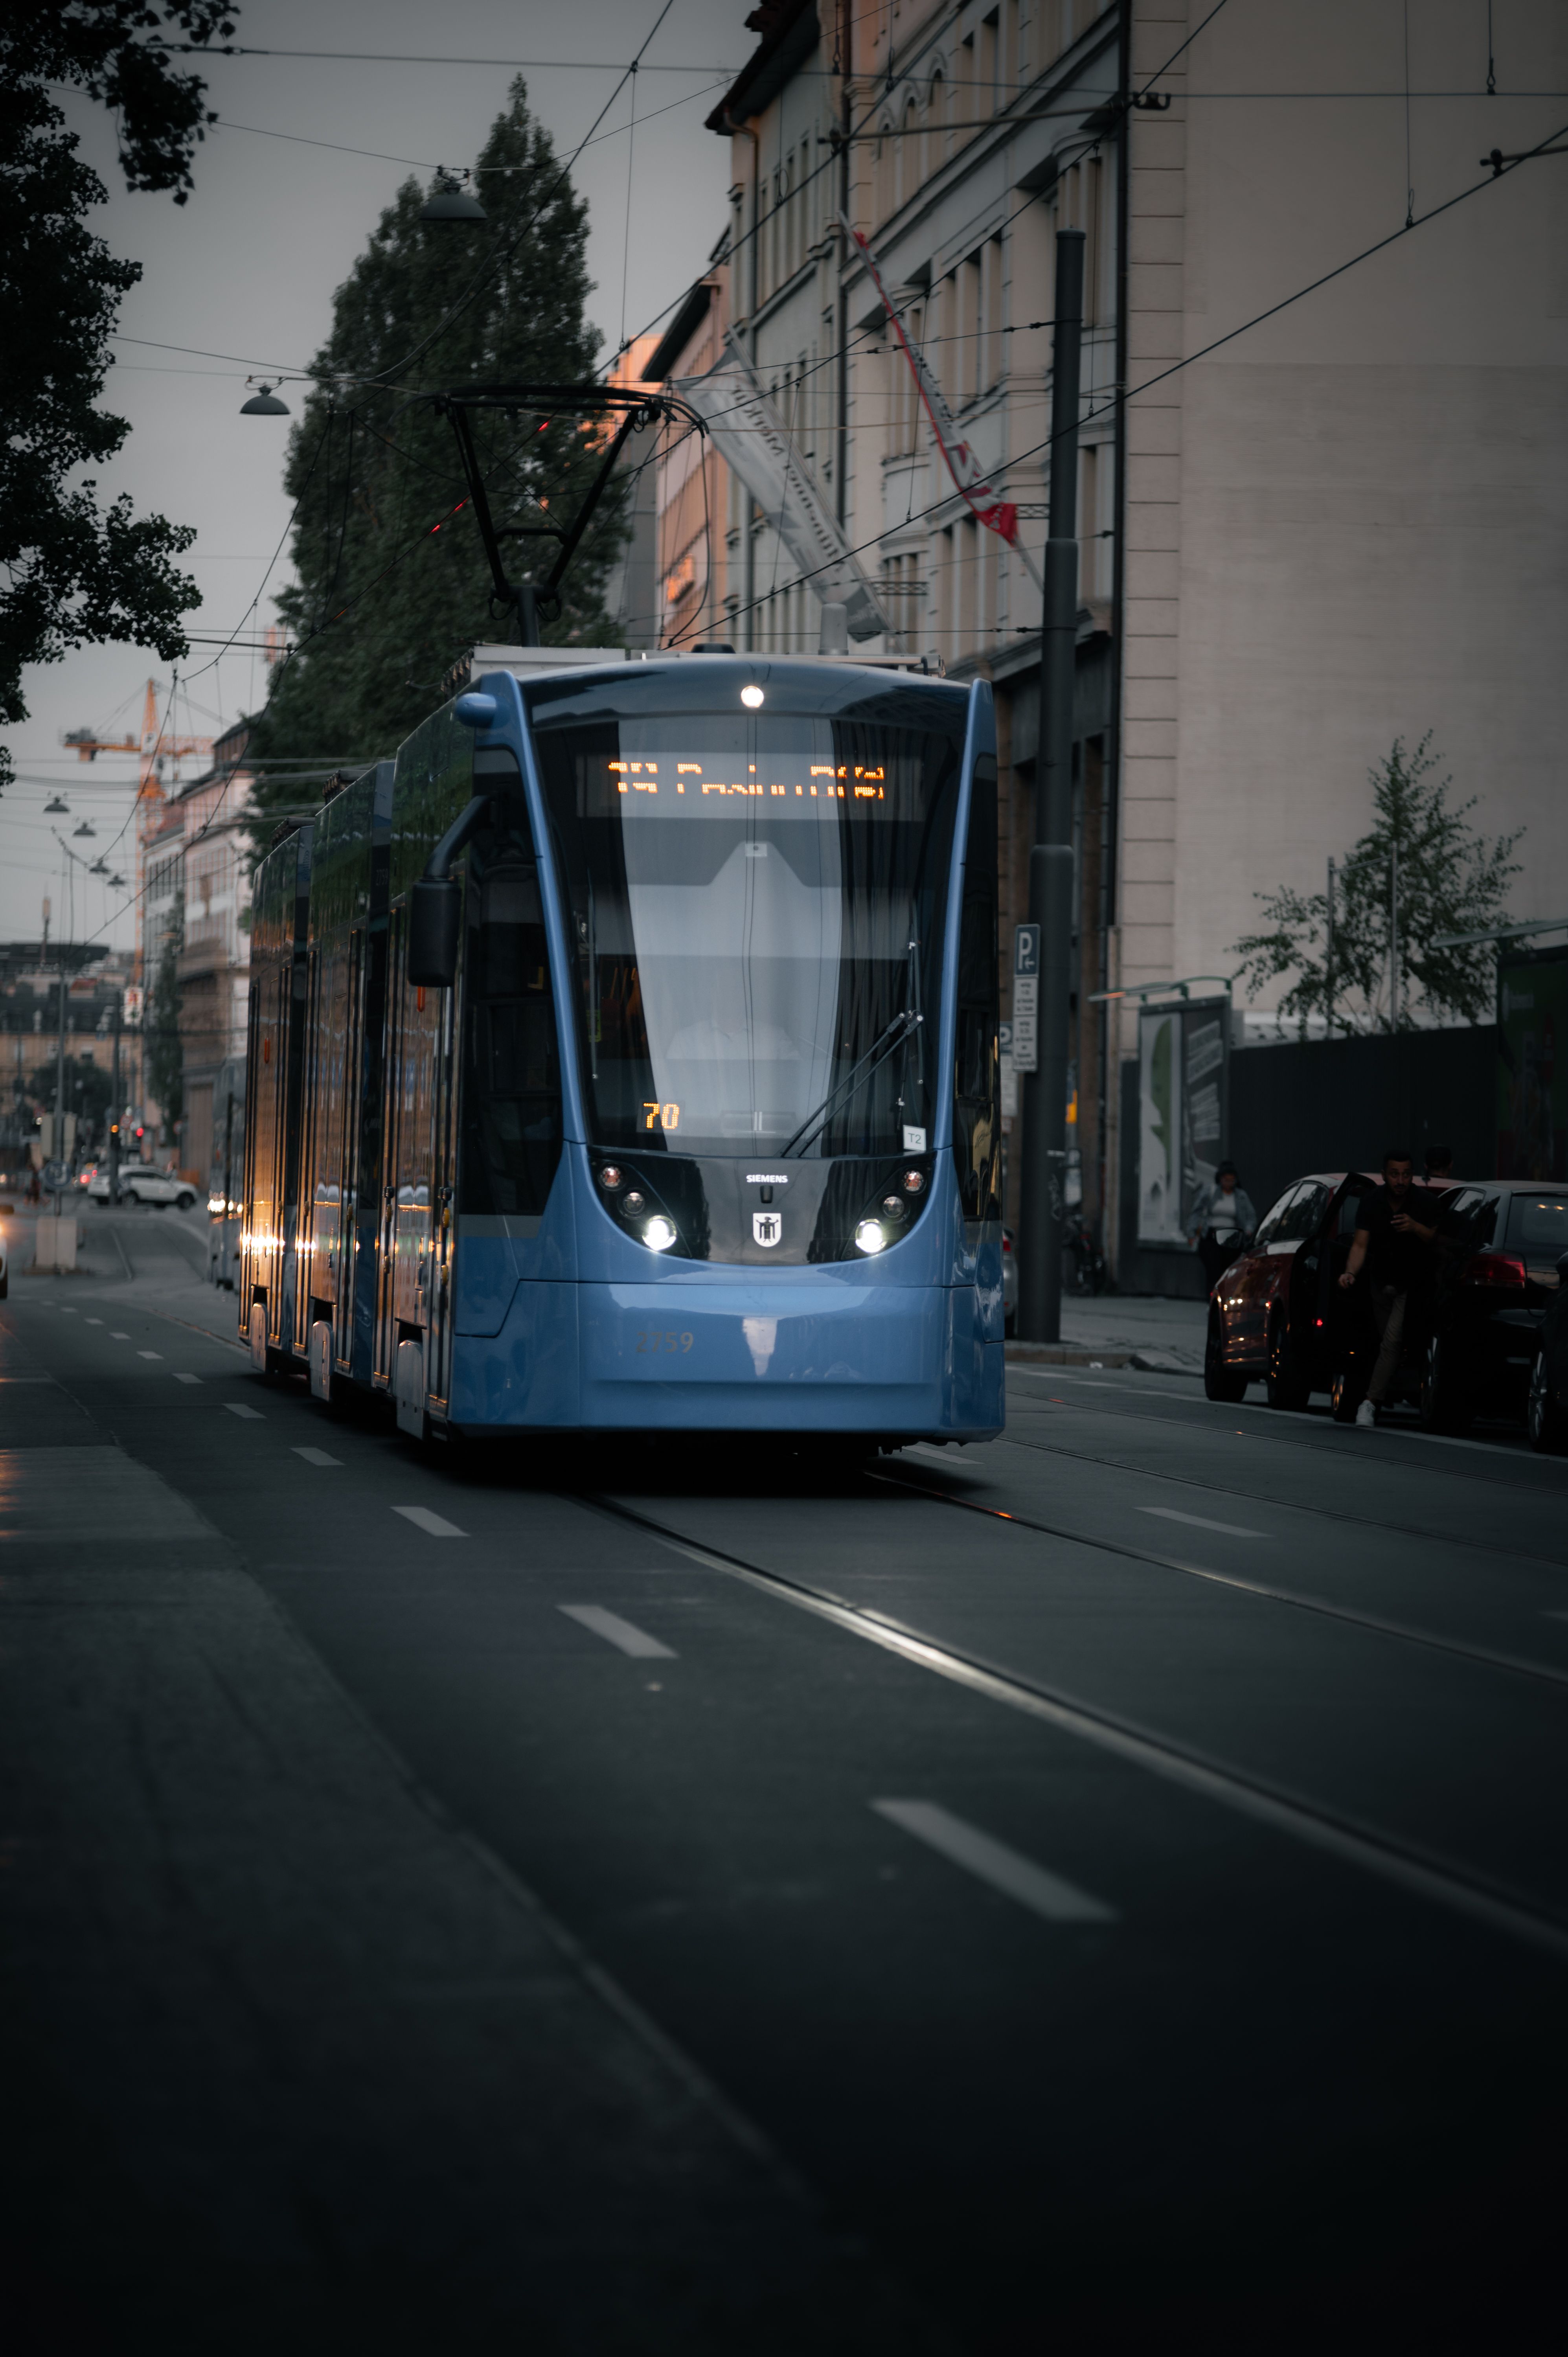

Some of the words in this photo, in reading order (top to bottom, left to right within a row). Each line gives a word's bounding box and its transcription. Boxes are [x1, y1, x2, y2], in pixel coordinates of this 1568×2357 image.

[1018, 932, 1033, 969] P
[643, 1103, 680, 1129] 70
[908, 1133, 922, 1144] T2
[746, 1174, 789, 1183] SIEMENS
[636, 1331, 694, 1354] 2759
